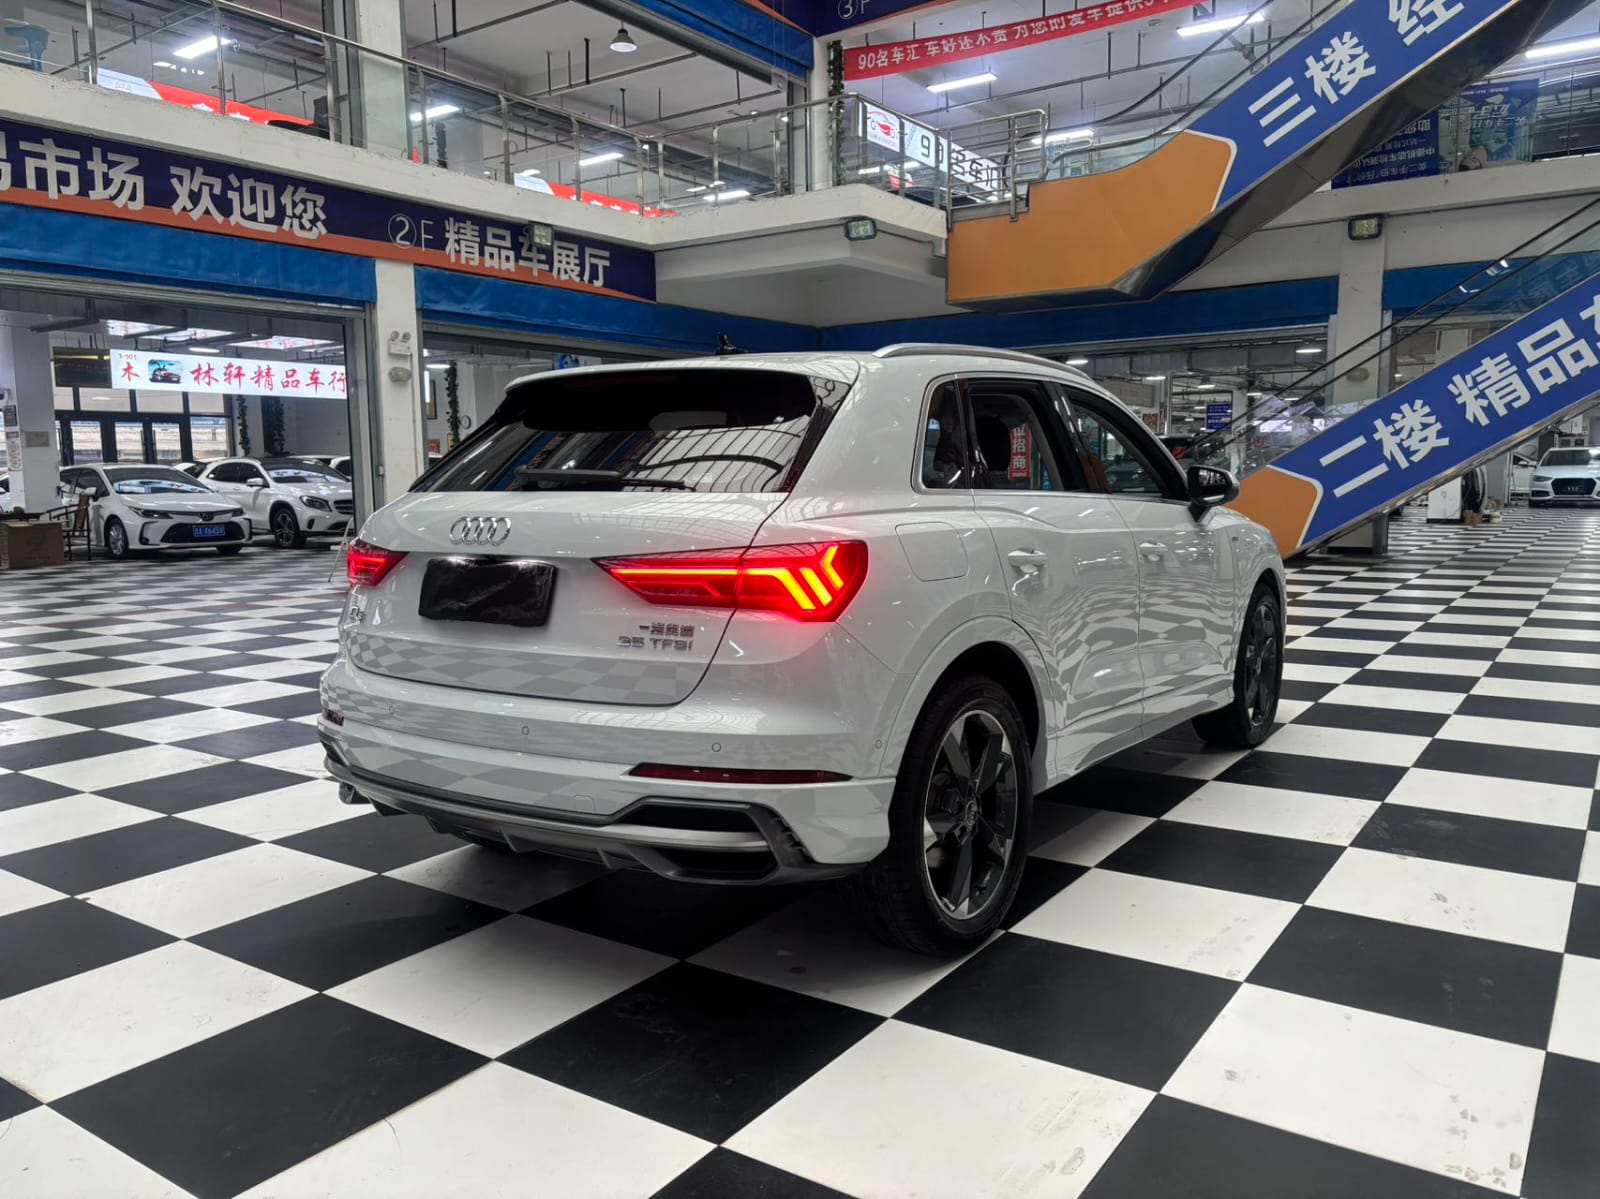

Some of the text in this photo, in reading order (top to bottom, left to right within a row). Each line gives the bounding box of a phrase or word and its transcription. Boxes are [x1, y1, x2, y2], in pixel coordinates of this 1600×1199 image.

[858, 44, 920, 70] 90名车汇
[1248, 31, 1376, 147] 三楼
[169, 165, 329, 239] 欢迎您
[444, 216, 611, 287] 精品车展厅
[189, 360, 348, 393] 林轩精品车行
[1319, 399, 1450, 499] 二楼
[618, 635, 645, 648] 35
